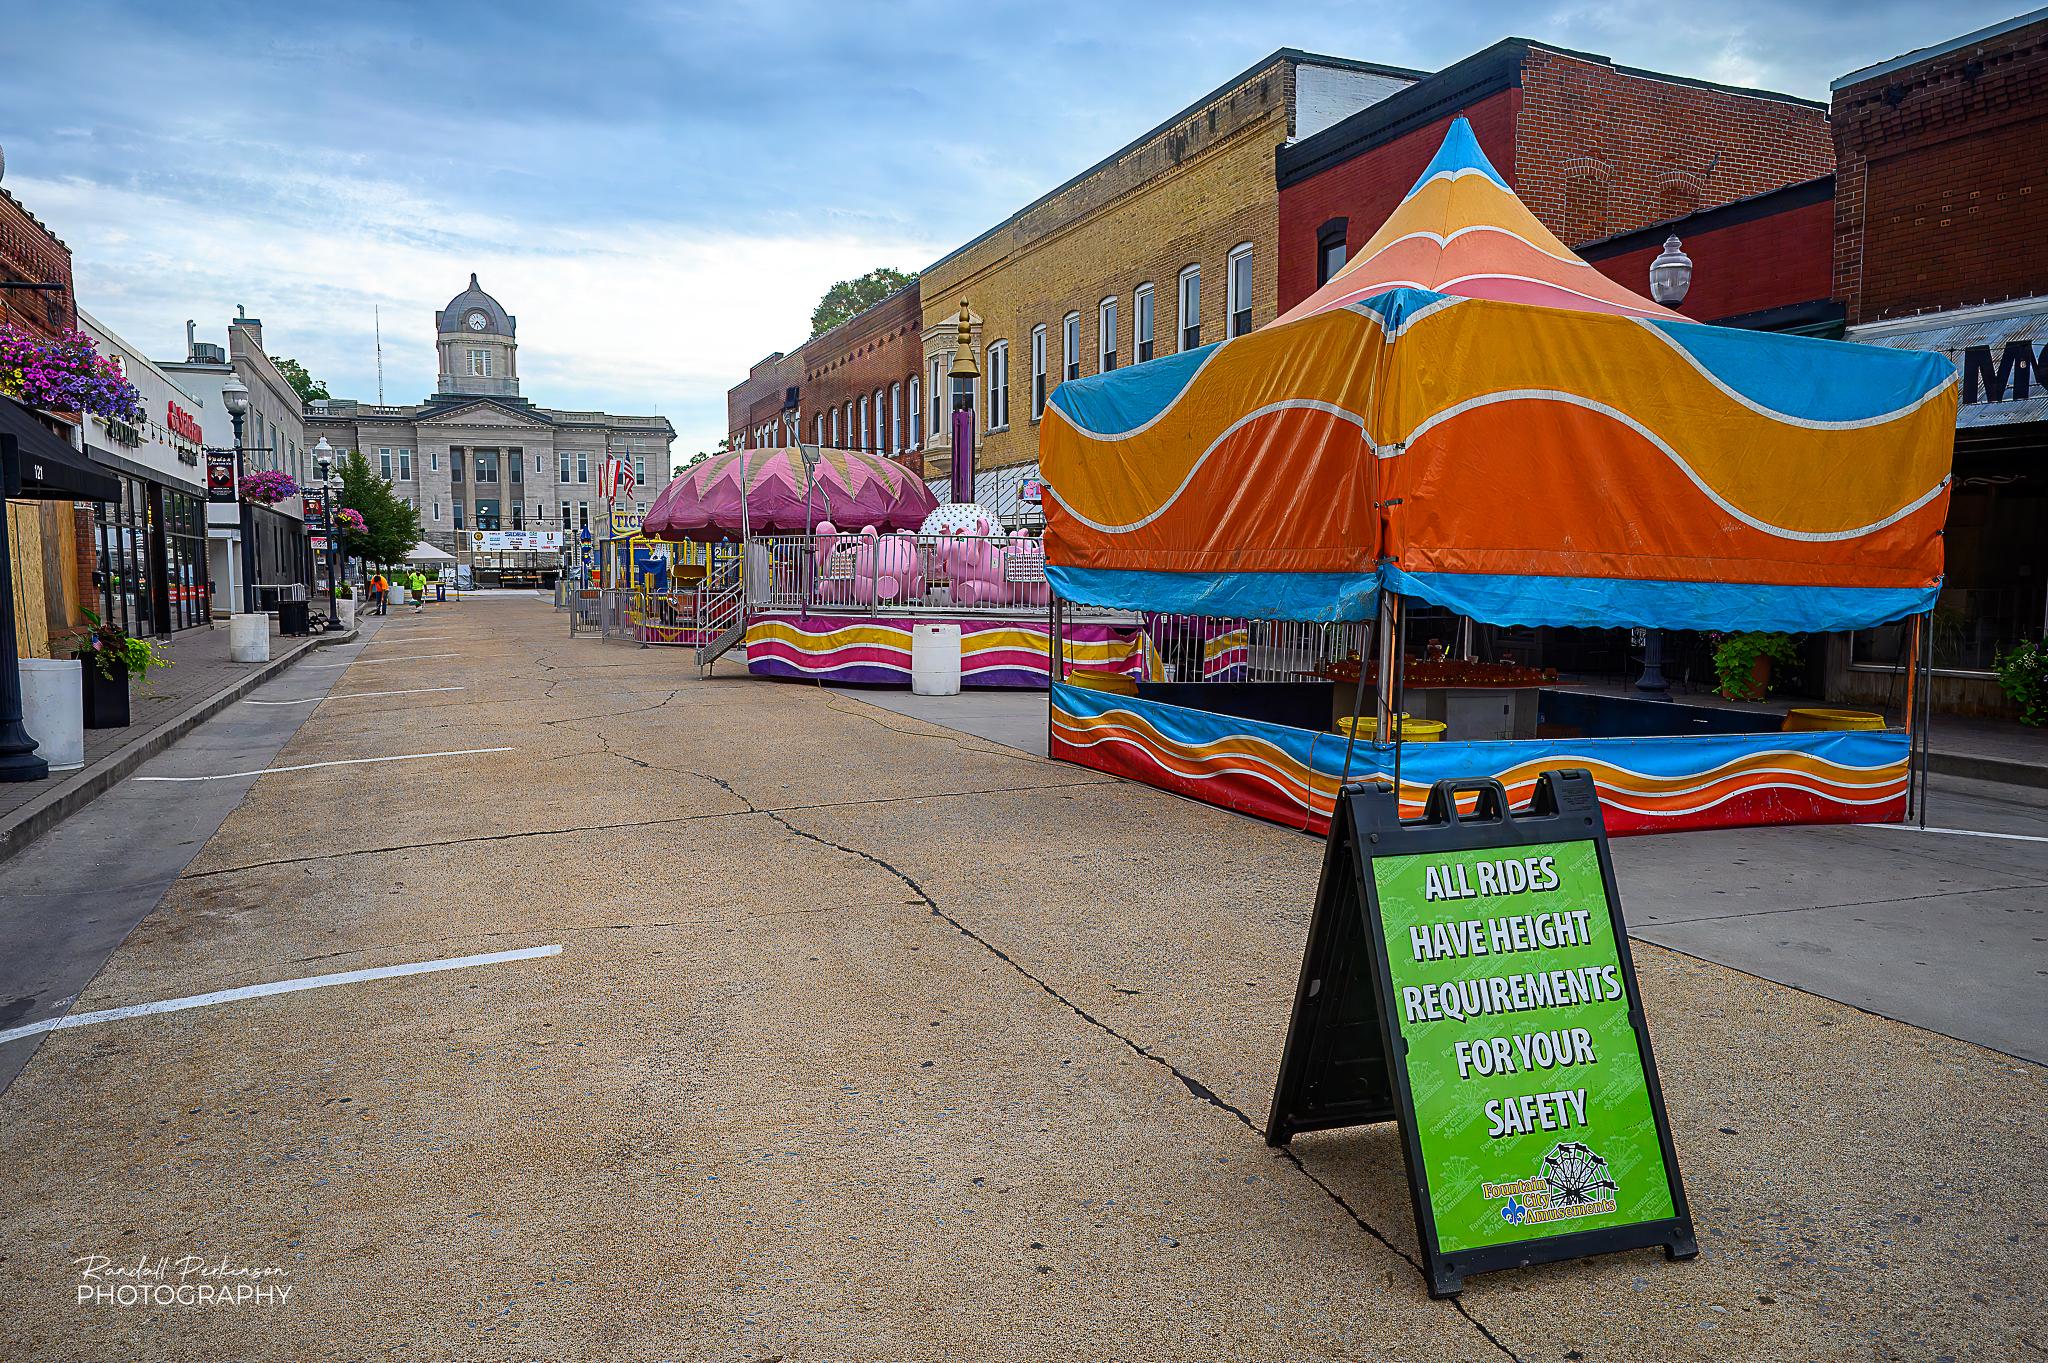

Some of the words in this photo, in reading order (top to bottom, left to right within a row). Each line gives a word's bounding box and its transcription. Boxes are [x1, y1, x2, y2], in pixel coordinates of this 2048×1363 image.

[1962, 339, 2048, 405] M
[1425, 863, 1477, 901] ALL
[1476, 856, 1561, 896] RIDES
[1409, 919, 1488, 962] HAVE
[1488, 909, 1592, 954] HEIGHT
[1402, 964, 1624, 1024] REQUIREMENTS
[1455, 1037, 1518, 1080] FOR
[1513, 1027, 1598, 1072] YOUR
[1484, 1088, 1588, 1139] SAFETY
[1482, 1176, 1547, 1199] Fountain
[1522, 1193, 1551, 1210] City
[1524, 1198, 1617, 1225] Amusements
